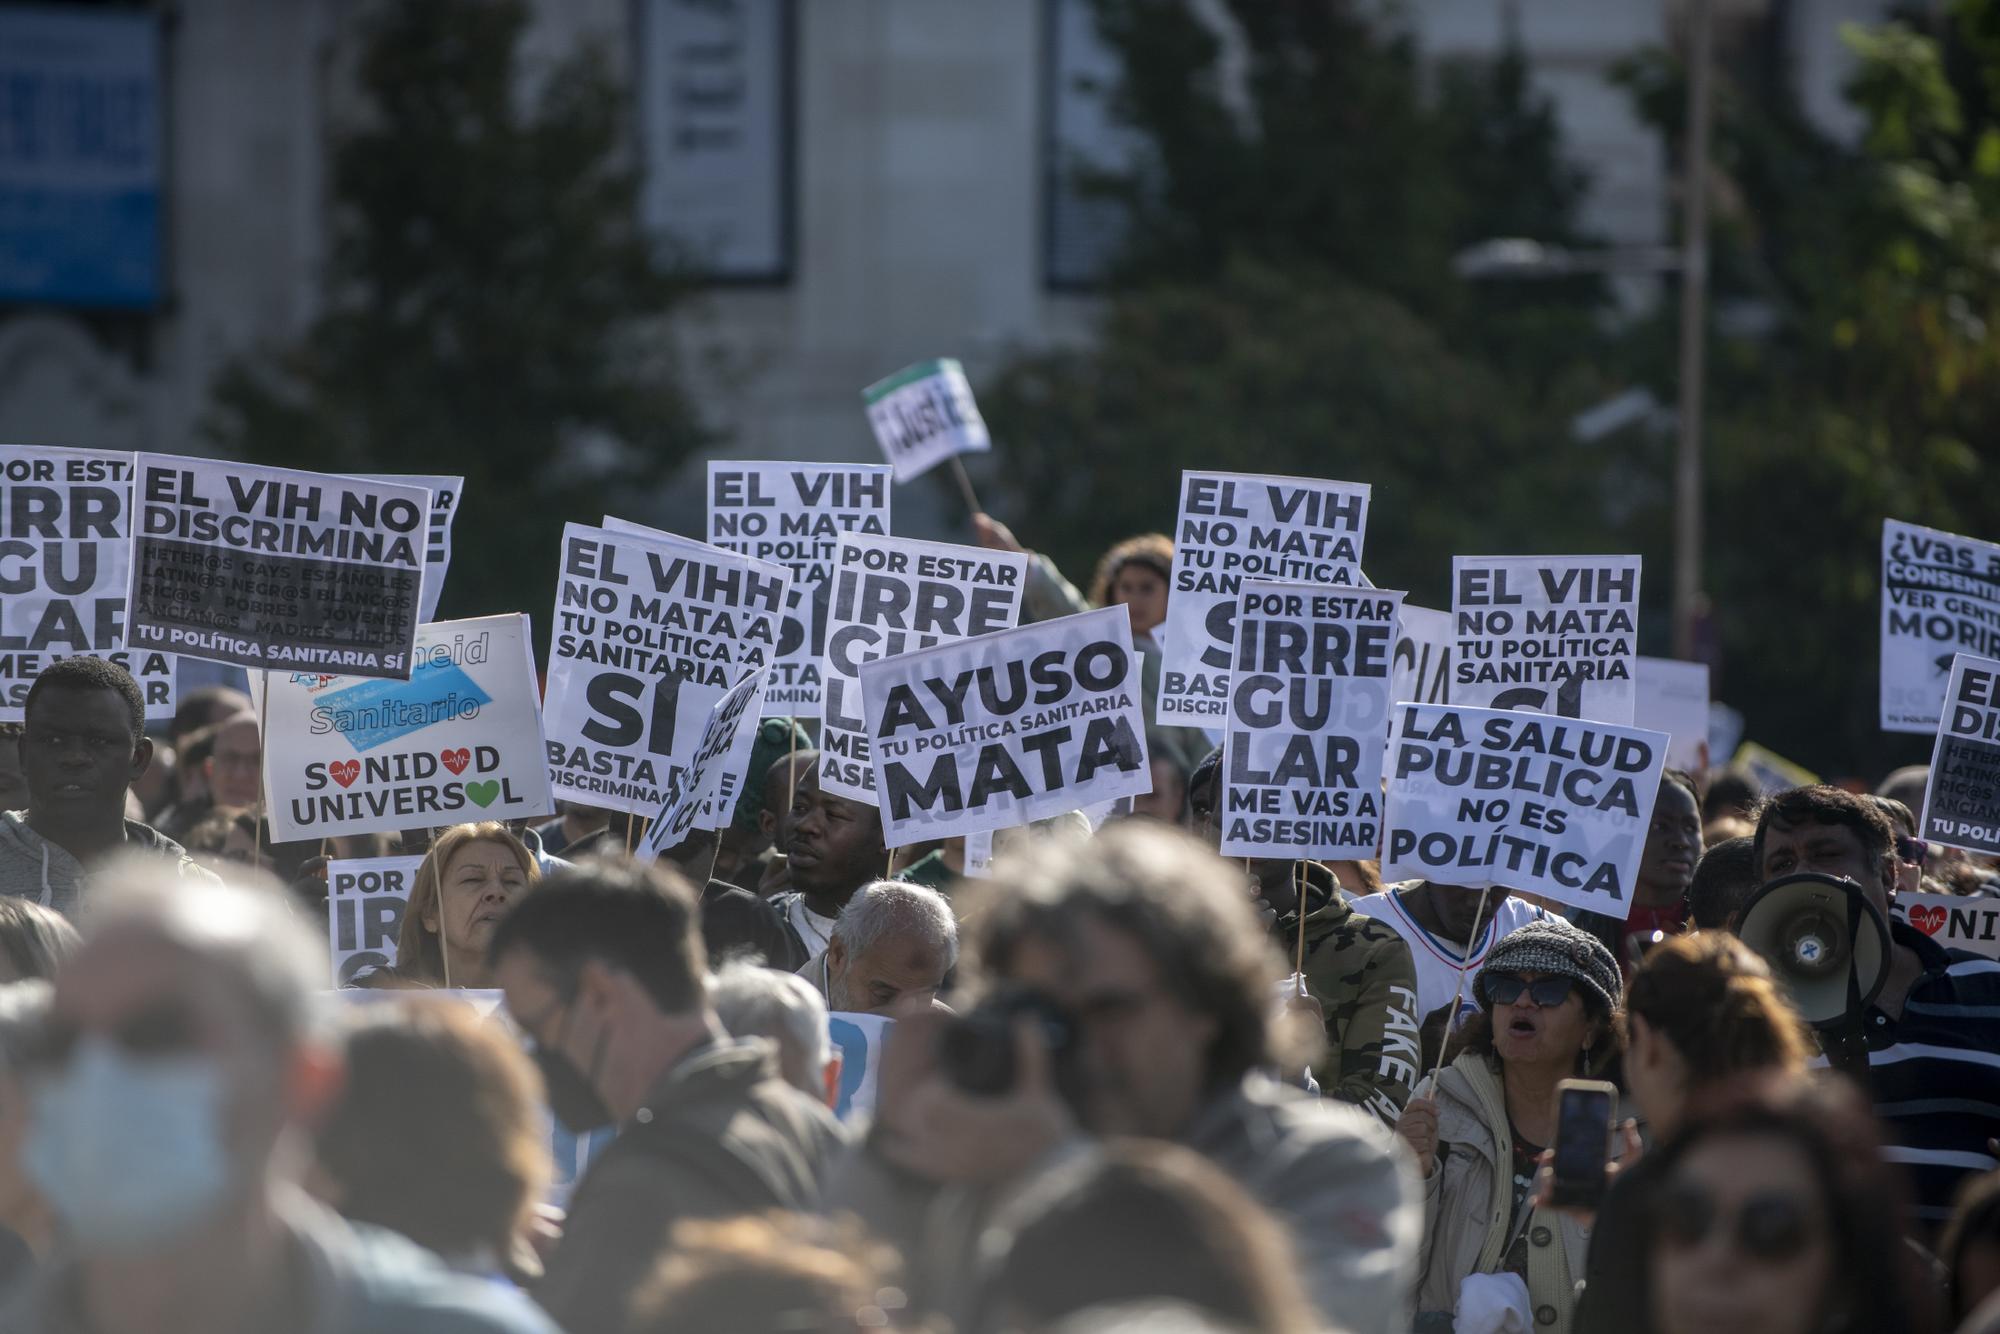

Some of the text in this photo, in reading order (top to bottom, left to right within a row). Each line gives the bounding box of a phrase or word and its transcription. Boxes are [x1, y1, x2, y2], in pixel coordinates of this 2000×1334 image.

[0, 460, 54, 481] OR
[714, 472, 884, 508] EL VIH
[0, 486, 133, 538] RR
[145, 466, 210, 508] EL
[226, 475, 321, 522] VIH
[340, 491, 421, 533] NO
[1185, 478, 1362, 532] EL VIH
[144, 505, 418, 567] DISCRIMINA
[714, 513, 885, 537] NO MATA
[1181, 519, 1358, 563] NO MATA
[144, 547, 233, 571] HETER@S
[243, 561, 291, 579] GAYS
[566, 536, 629, 586] EL
[646, 551, 741, 607] VIH
[842, 545, 907, 574] POR
[917, 555, 1018, 587] ESTAR
[1180, 548, 1352, 586] TU POLÍTICA
[141, 584, 201, 604] RIC@S
[225, 596, 298, 618] POBRES
[142, 565, 410, 610] LATIN@S NEGR@S BLANC@S
[834, 570, 1014, 637] IRRE
[1243, 593, 1393, 621] POR ESTAR
[1459, 569, 1635, 605] EL VIH
[1889, 587, 1936, 609] VER
[138, 602, 407, 646] ANCIAN@S MADRES HIJOS
[562, 580, 618, 614] NO
[630, 594, 737, 639] MATA
[1458, 609, 1634, 635] NO MATA
[137, 624, 406, 670] TU POLÍTICA SANITARIA SÍ
[560, 611, 596, 635] TU
[604, 620, 731, 664] POLÍTICA
[1239, 619, 1389, 678] IRRE
[1457, 634, 1630, 658] TU POLÍTICA
[141, 653, 170, 675] A
[557, 634, 729, 689] SANITARIA
[1457, 660, 1630, 683] SANITARIA
[877, 640, 1128, 739] AYUSO
[1233, 674, 1332, 732] GU
[310, 693, 481, 735] Sanitario
[880, 693, 1133, 758] TU POLÍTICA SANITARIA
[546, 740, 656, 785] BASTA
[1230, 731, 1360, 788] LAR
[1402, 708, 1652, 773] LA SALUD
[883, 714, 1143, 822] MATA
[1396, 745, 1640, 818] PÚBLICA
[1939, 778, 1993, 800] RIC@S
[1228, 788, 1377, 817] ME VAS A
[1457, 798, 1567, 834] NO ES
[1226, 818, 1375, 847] ASESINAR
[1932, 817, 1954, 834] TU
[336, 870, 404, 895] POR
[1390, 825, 1624, 901] POLÍTICA
[1378, 985, 1418, 1092] FAKE
